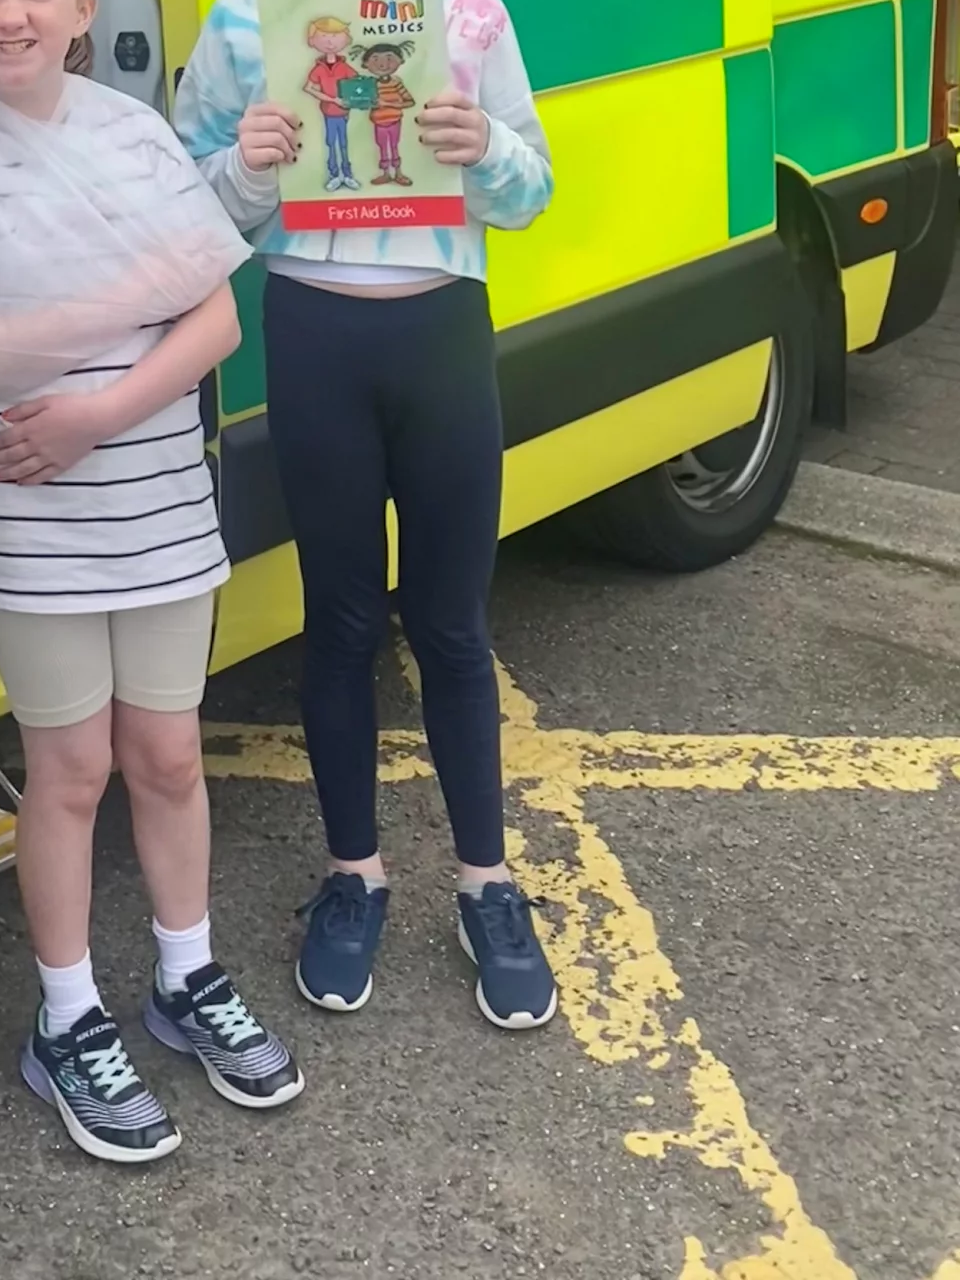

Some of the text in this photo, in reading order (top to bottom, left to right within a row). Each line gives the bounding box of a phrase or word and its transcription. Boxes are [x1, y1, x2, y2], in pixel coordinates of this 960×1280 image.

[363, 22, 424, 36] MEDICS
[328, 204, 416, 220] First Aid Book
